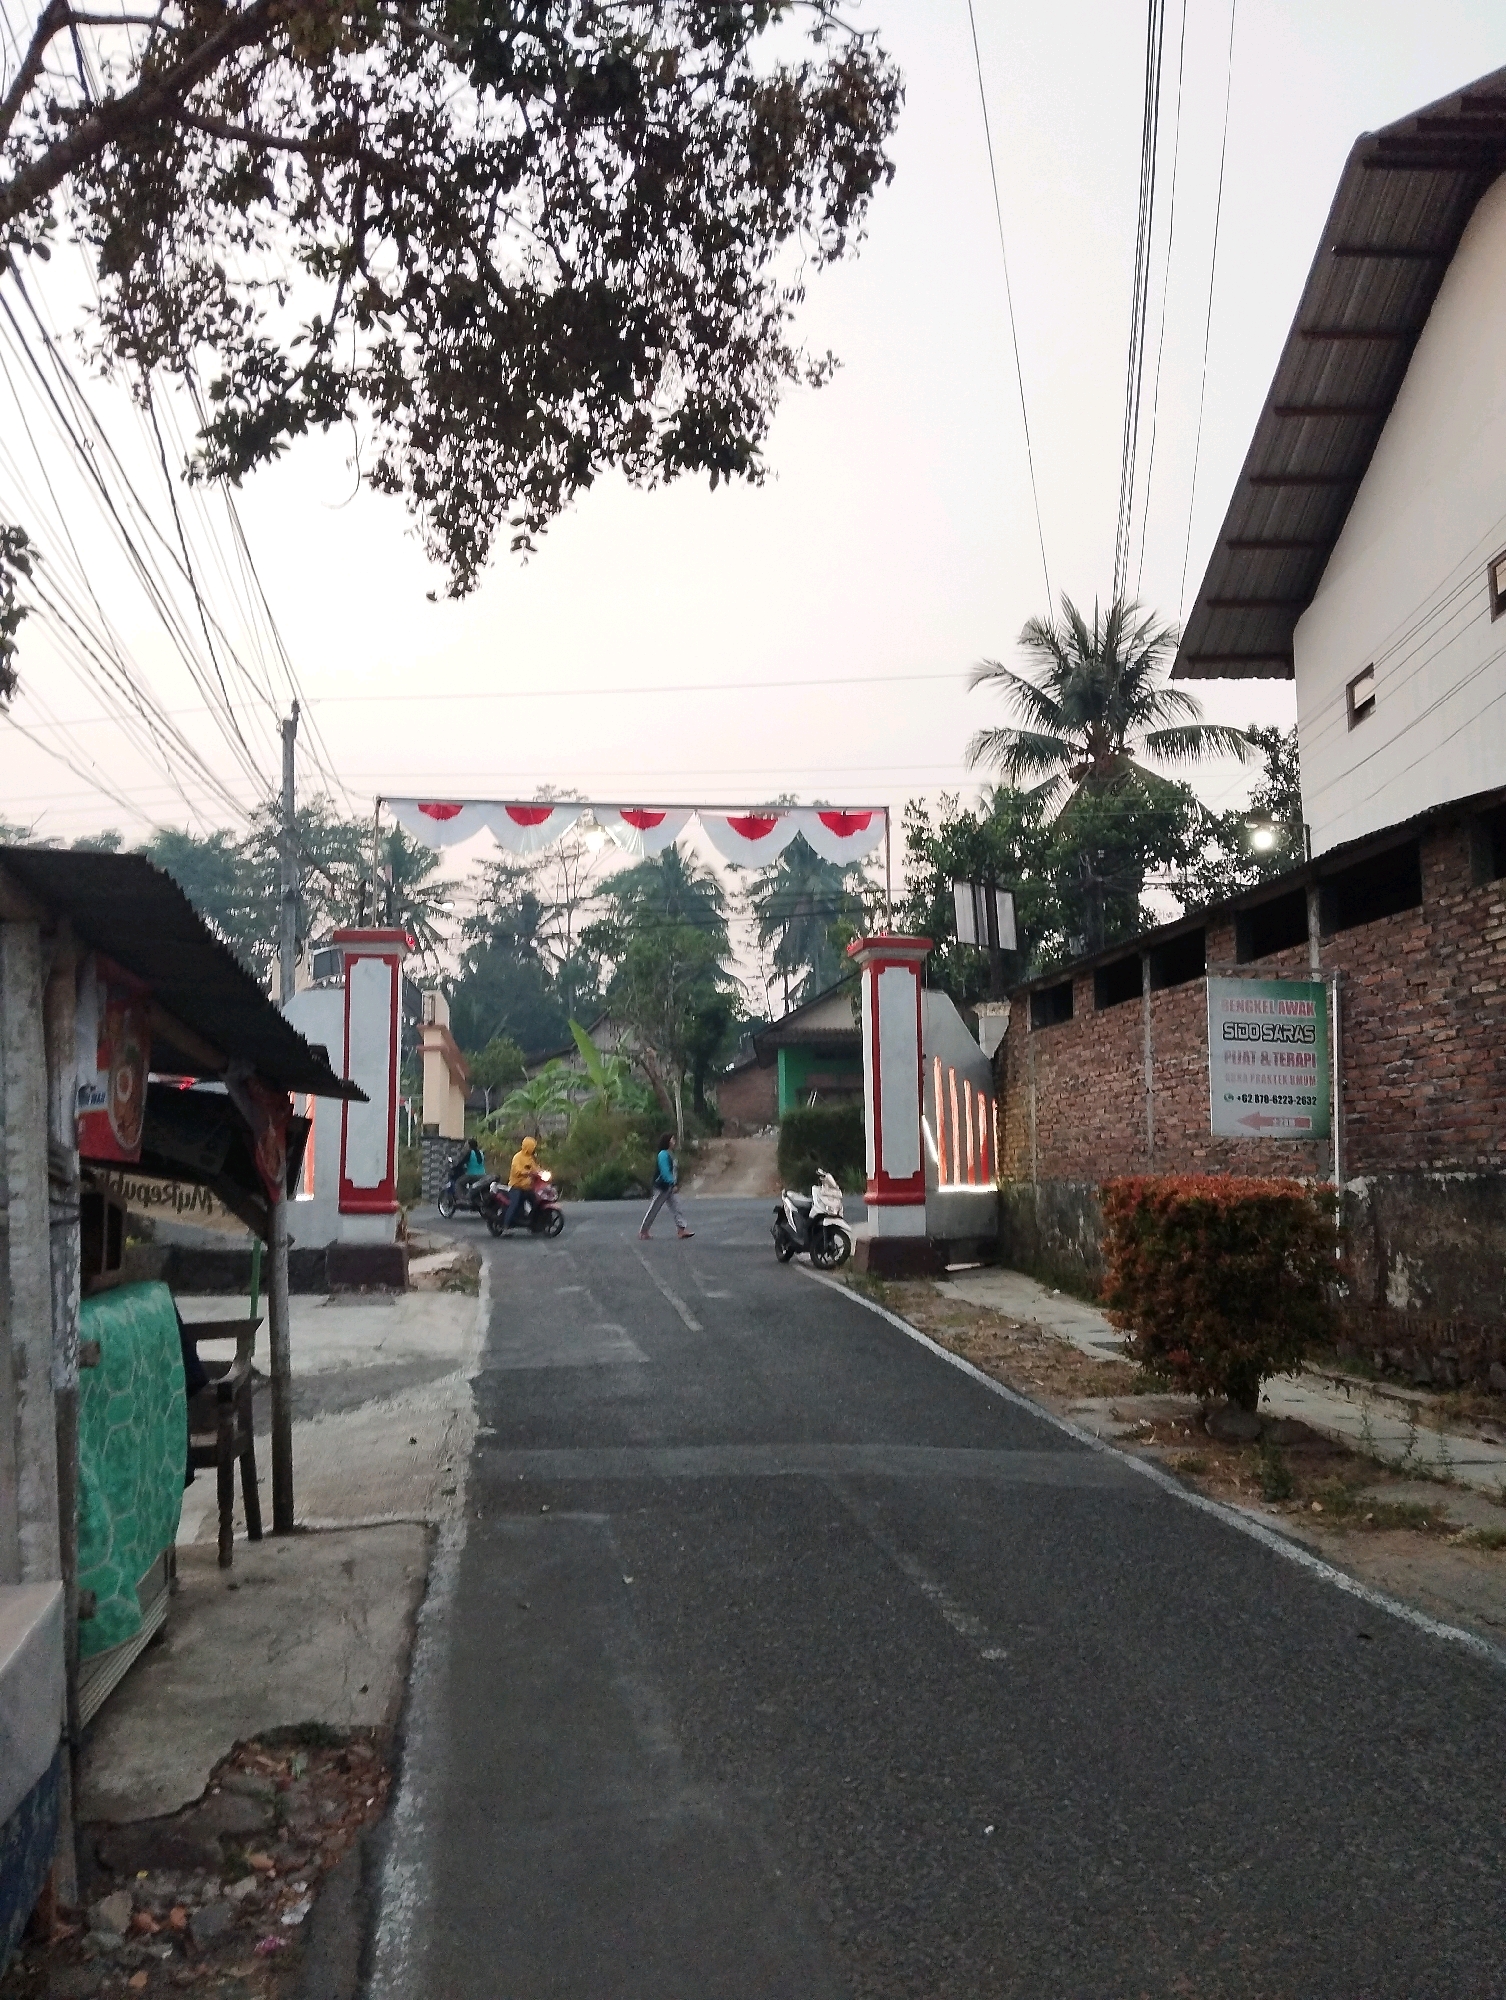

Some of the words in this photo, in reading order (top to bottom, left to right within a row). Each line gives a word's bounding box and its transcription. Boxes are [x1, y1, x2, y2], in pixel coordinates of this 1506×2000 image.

[1221, 999, 1275, 1015] BENGKEL
[1278, 1000, 1315, 1016] AWAK
[1223, 1021, 1260, 1041] SIDO
[1261, 1023, 1316, 1043] SARAS
[1224, 1049, 1256, 1066] PIJAT
[1260, 1050, 1271, 1066] &
[1272, 1051, 1317, 1068] TERAPI
[1250, 1073, 1288, 1085] PRAKTEK
[1290, 1075, 1317, 1086] UMUM
[1237, 1093, 1253, 1103] +62
